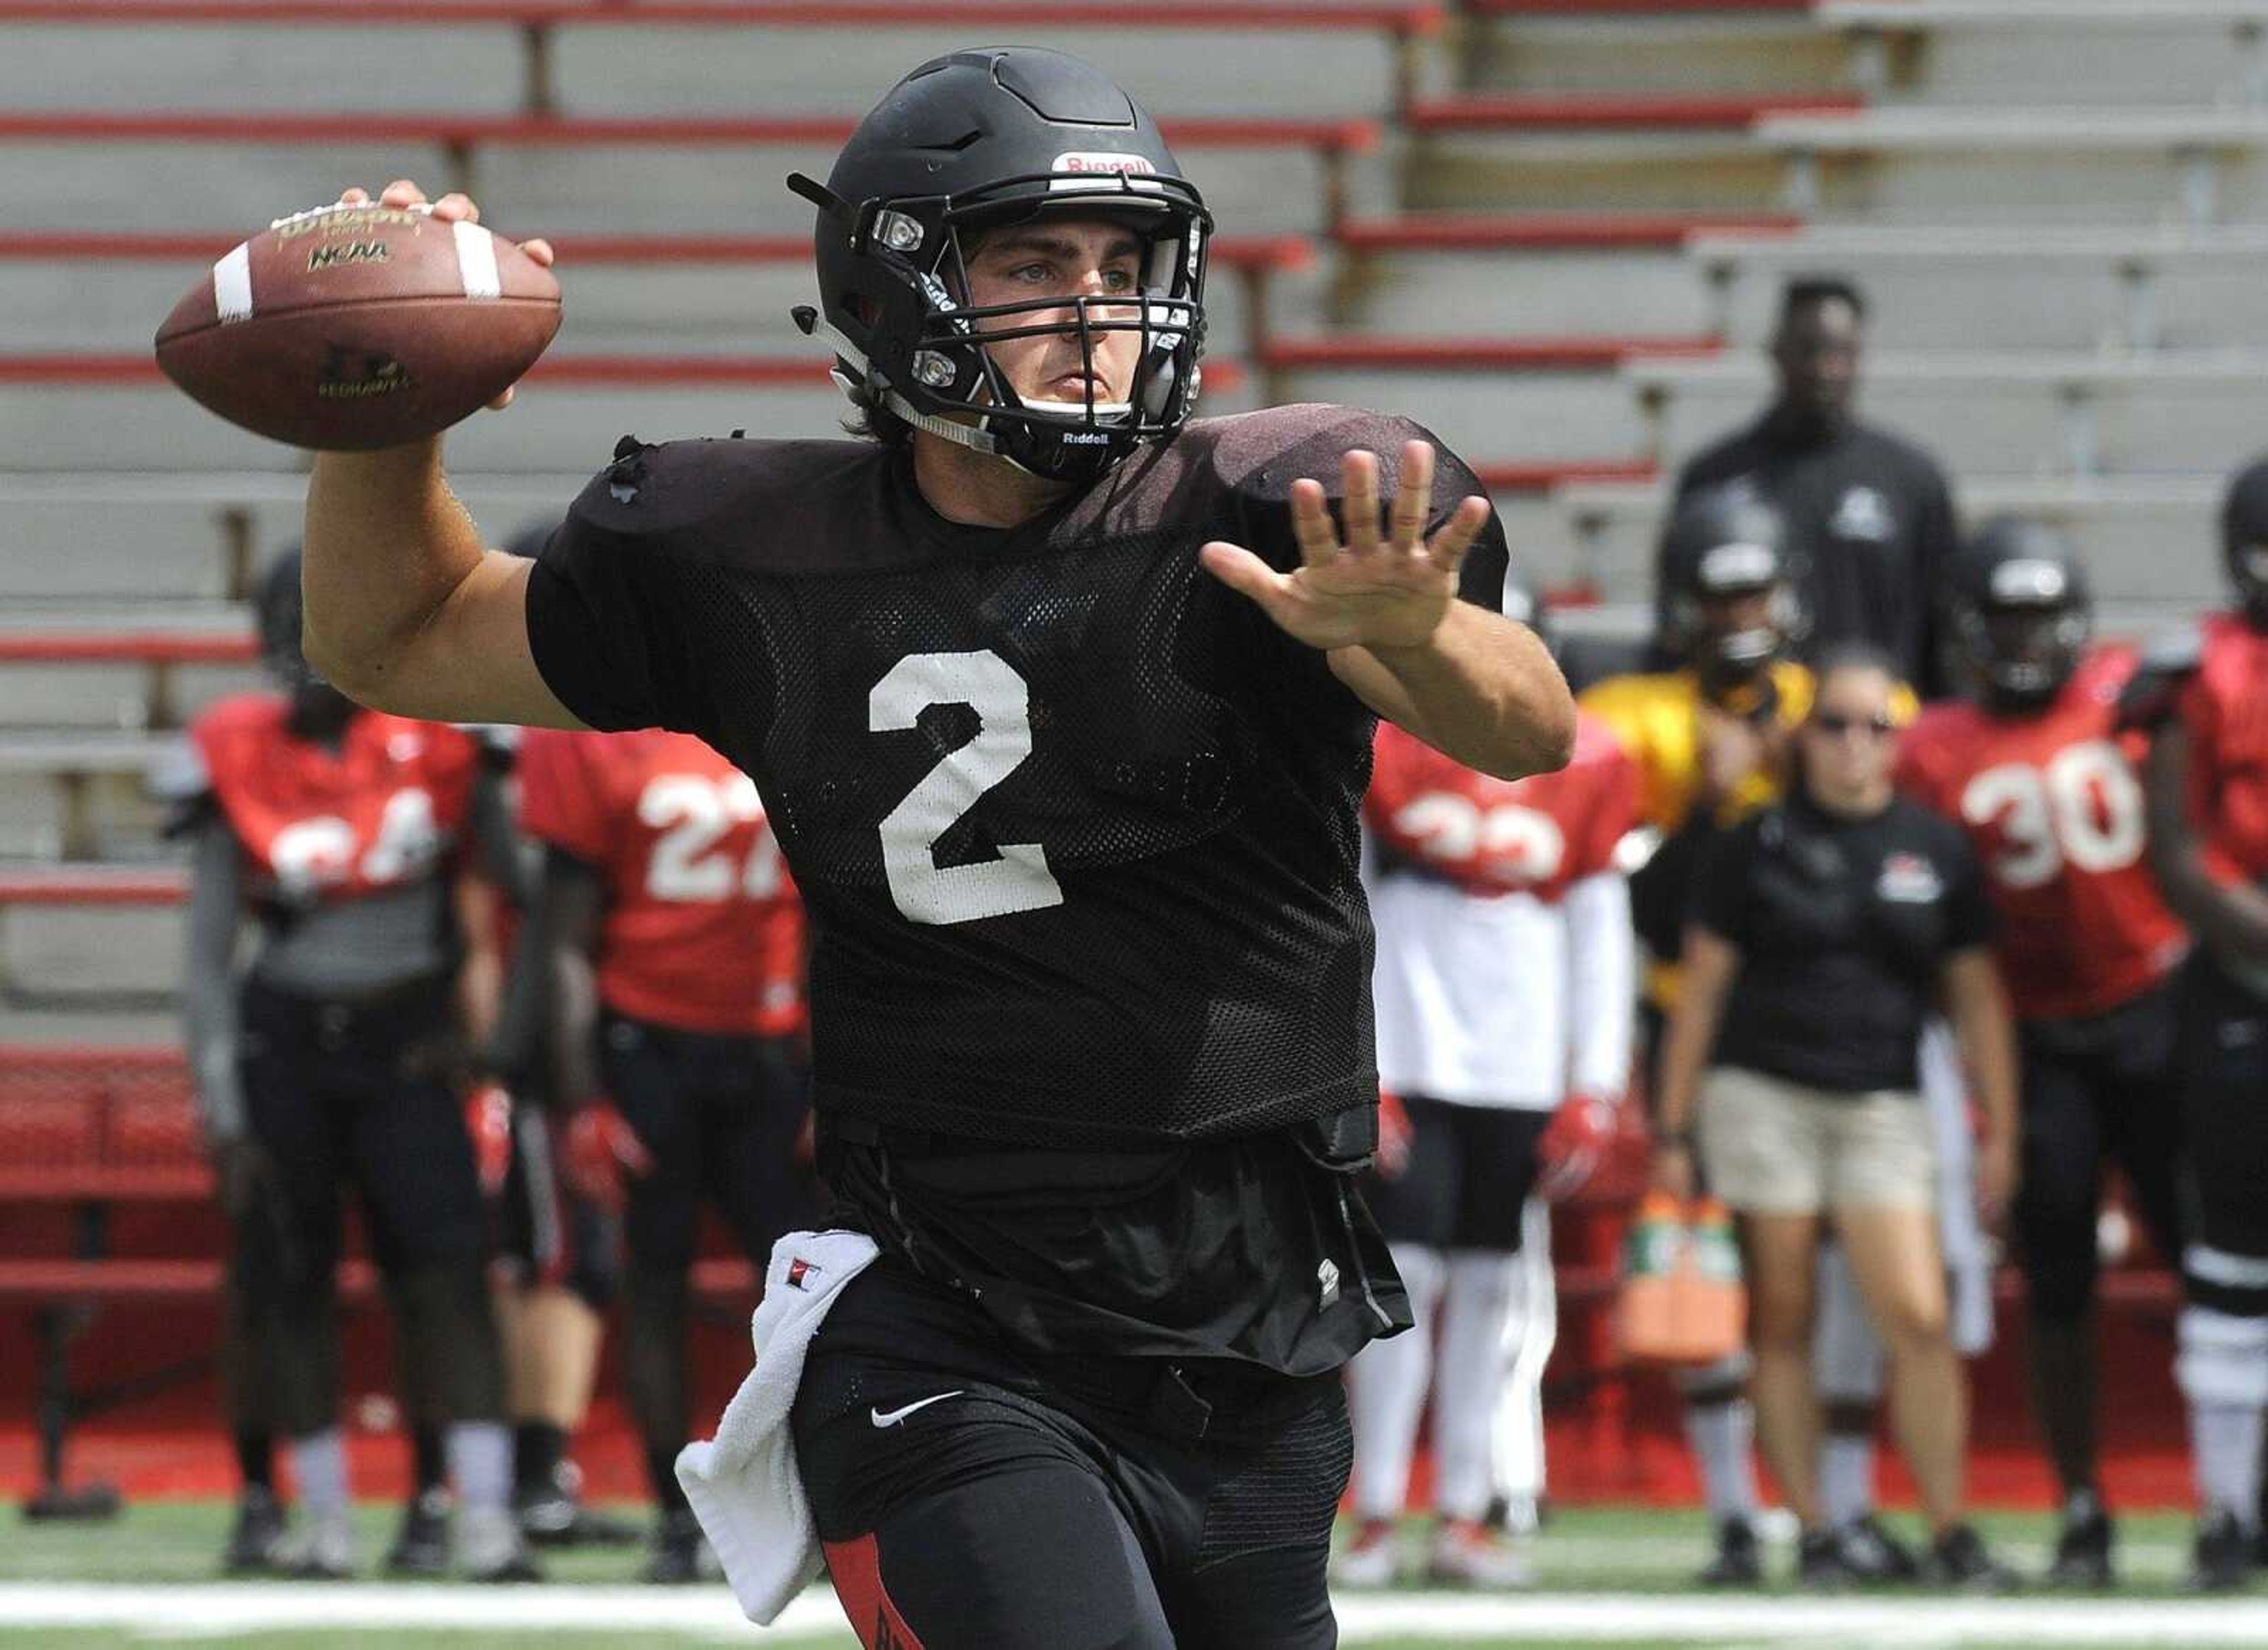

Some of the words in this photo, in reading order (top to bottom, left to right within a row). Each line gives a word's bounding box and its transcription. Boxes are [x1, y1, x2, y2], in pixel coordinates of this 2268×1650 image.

[1063, 432, 1109, 444] Riddell
[869, 650, 1063, 924] 2
[1962, 739, 2149, 887] 30
